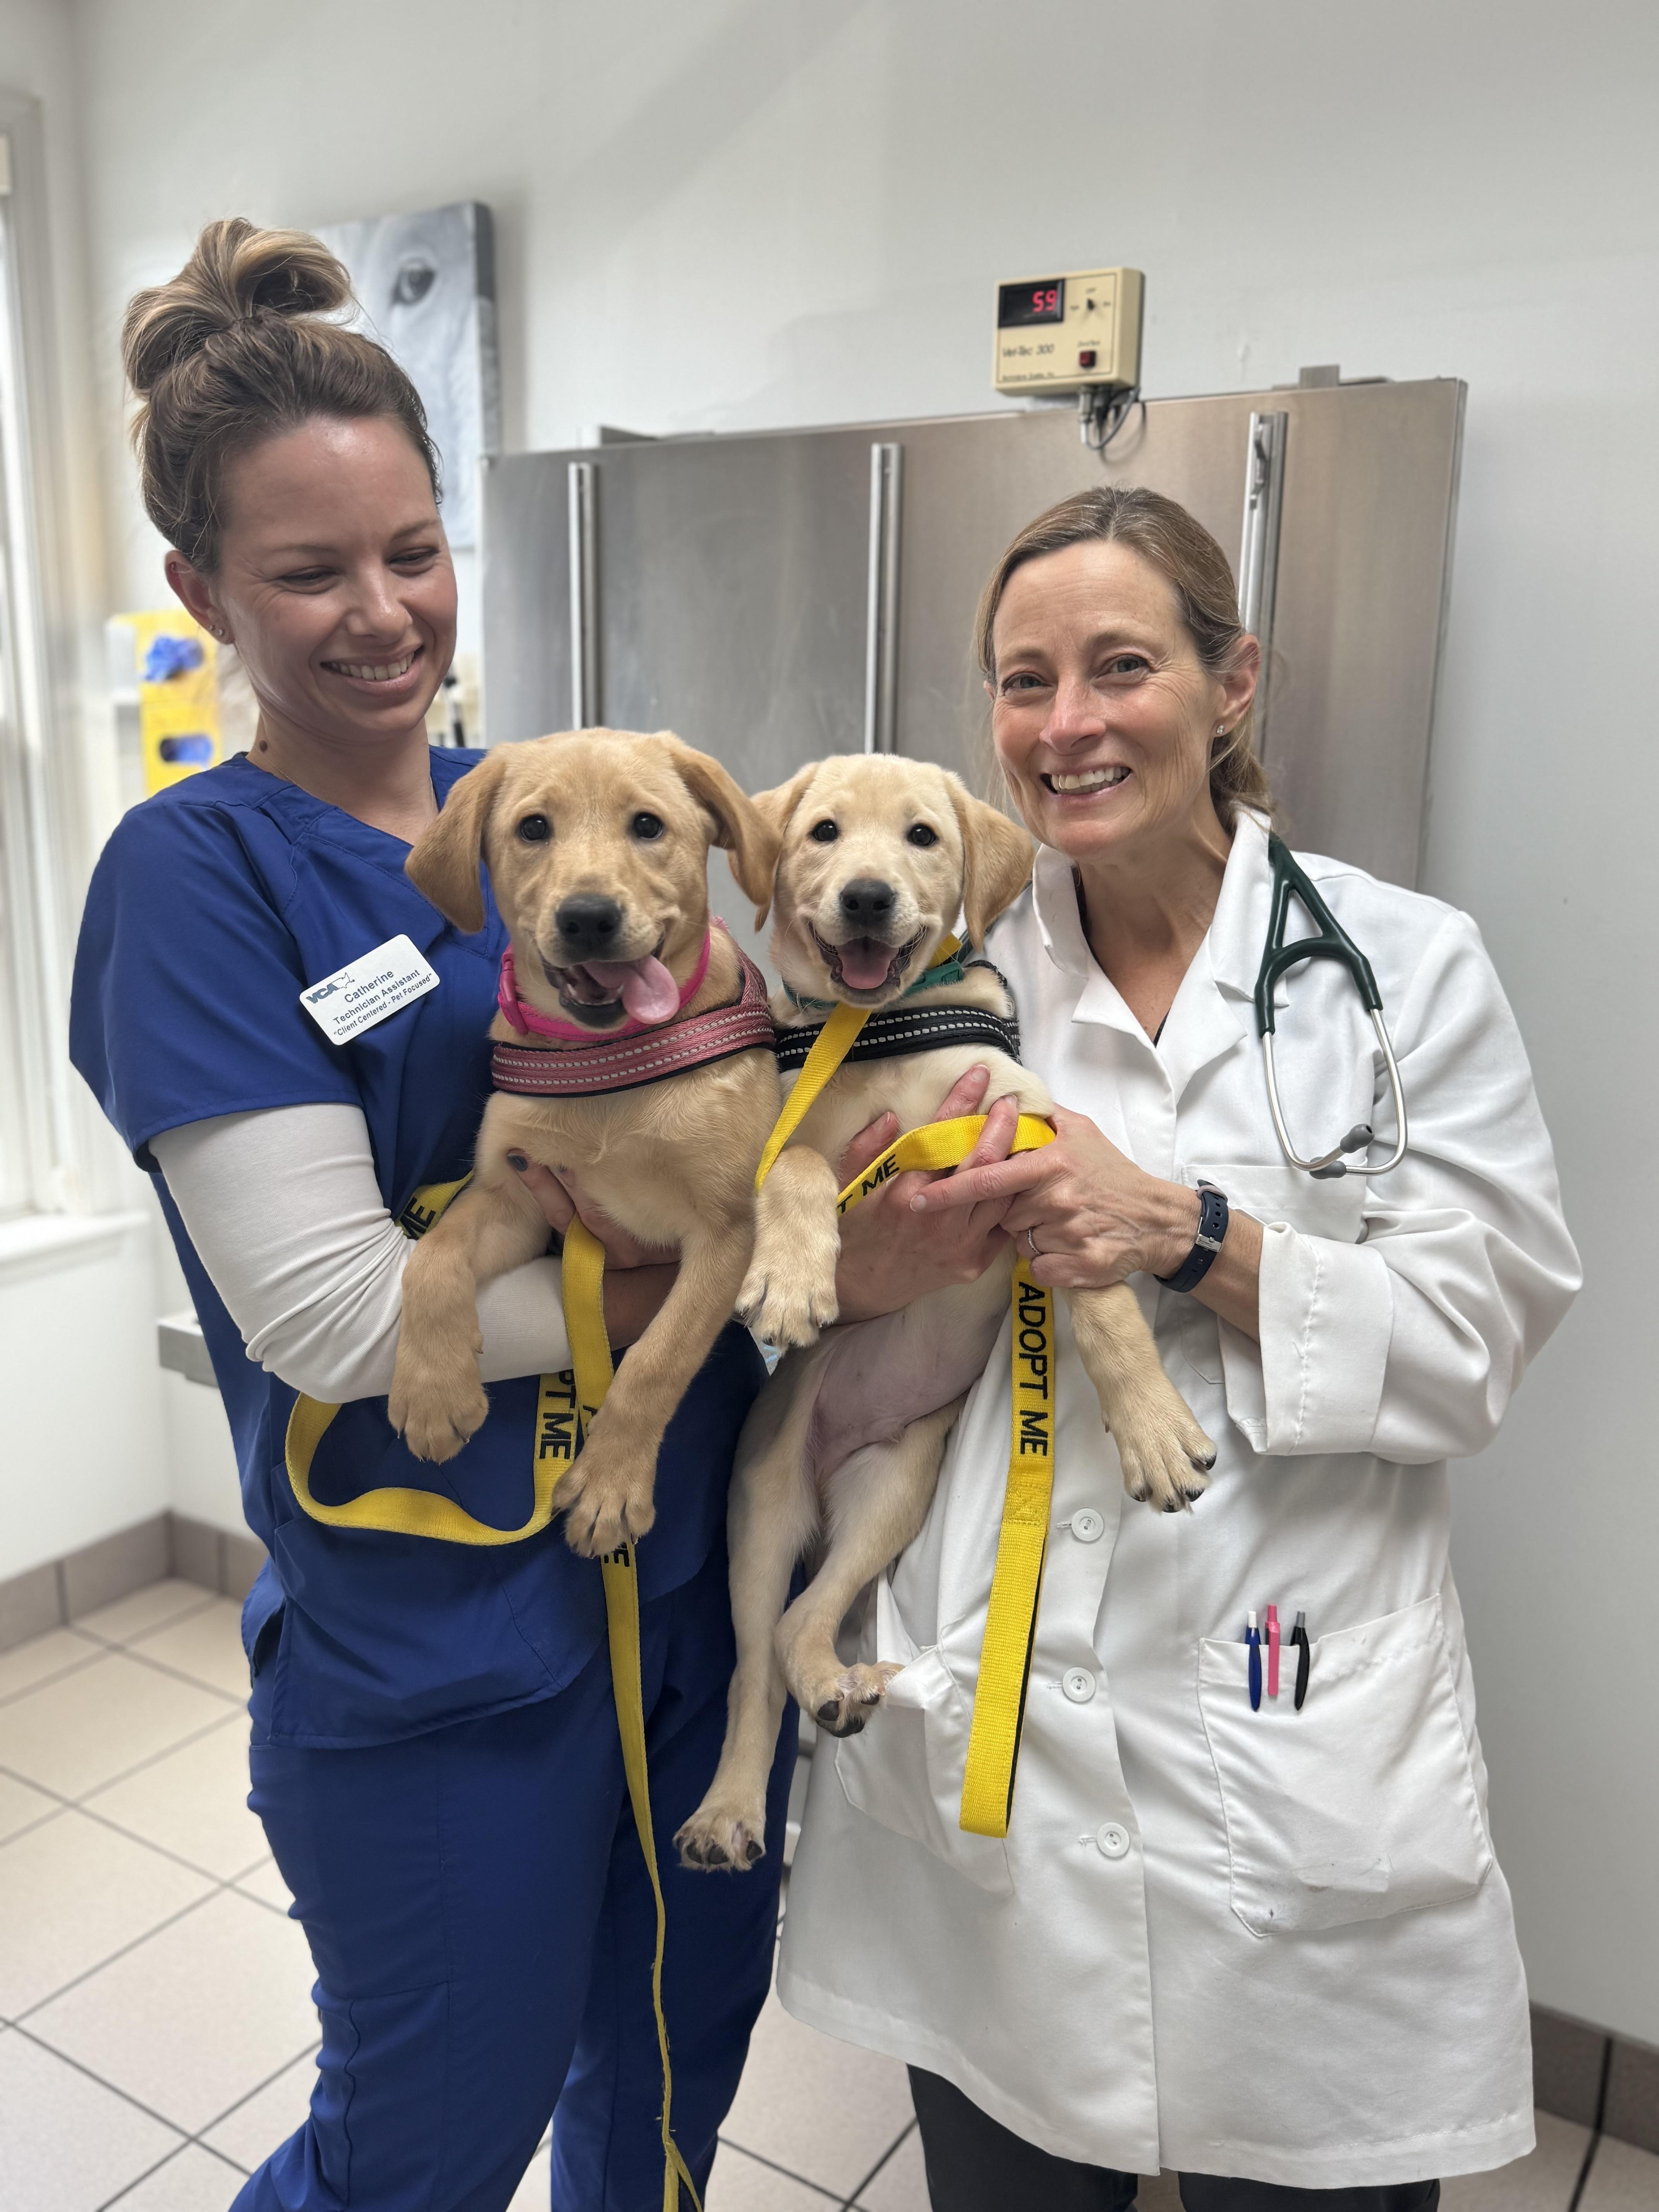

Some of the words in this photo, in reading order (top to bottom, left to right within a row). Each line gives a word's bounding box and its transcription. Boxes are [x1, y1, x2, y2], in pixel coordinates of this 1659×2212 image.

[1032, 289, 1057, 313] 59
[306, 983, 340, 1004] VCA
[333, 995, 380, 1024] Technician
[381, 969, 420, 997] Assistant
[344, 971, 394, 1003] Catherine
[358, 1003, 387, 1023] Centered
[391, 992, 402, 1003] Pet
[862, 1154, 900, 1197] ME
[1018, 1281, 1048, 1400] ADOPT
[539, 1413, 574, 1460] ME
[1019, 1410, 1048, 1456] ME
